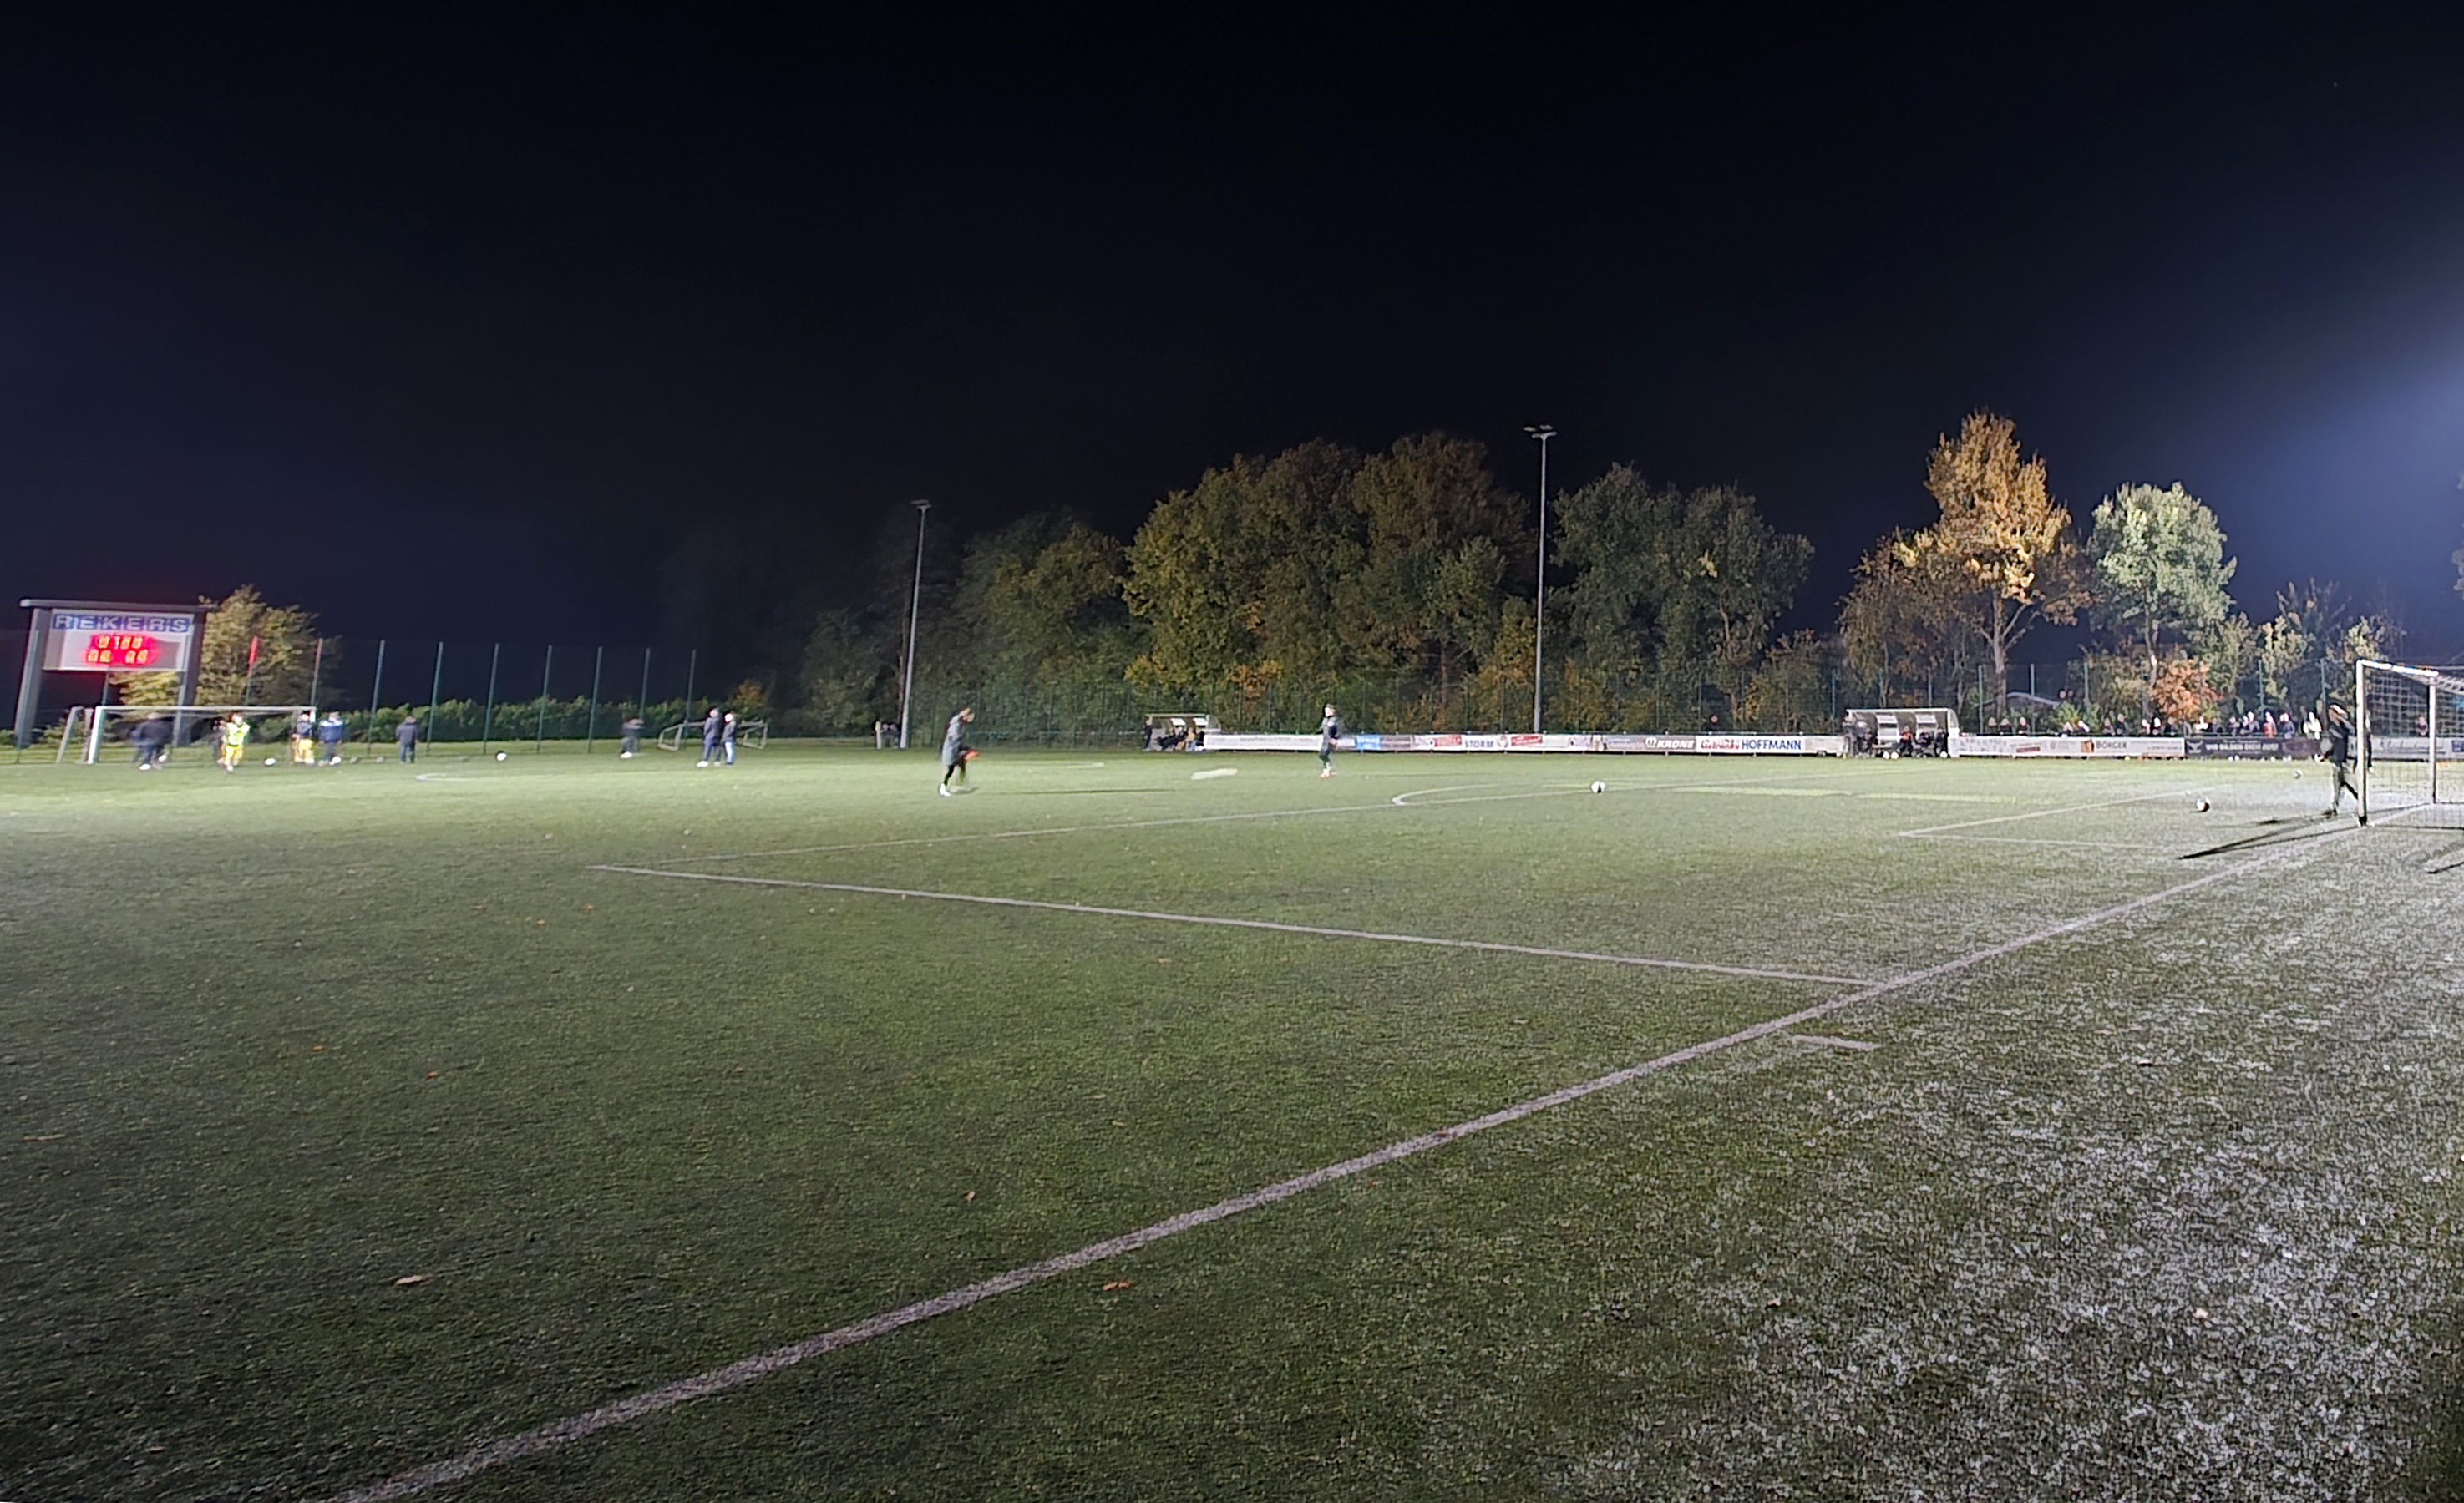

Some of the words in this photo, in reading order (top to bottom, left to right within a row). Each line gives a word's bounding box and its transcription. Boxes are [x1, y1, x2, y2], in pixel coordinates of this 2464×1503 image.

[54, 615, 187, 632] REKERS
[1465, 740, 1494, 749] STORM
[1742, 740, 1802, 750] HOFFMANN
